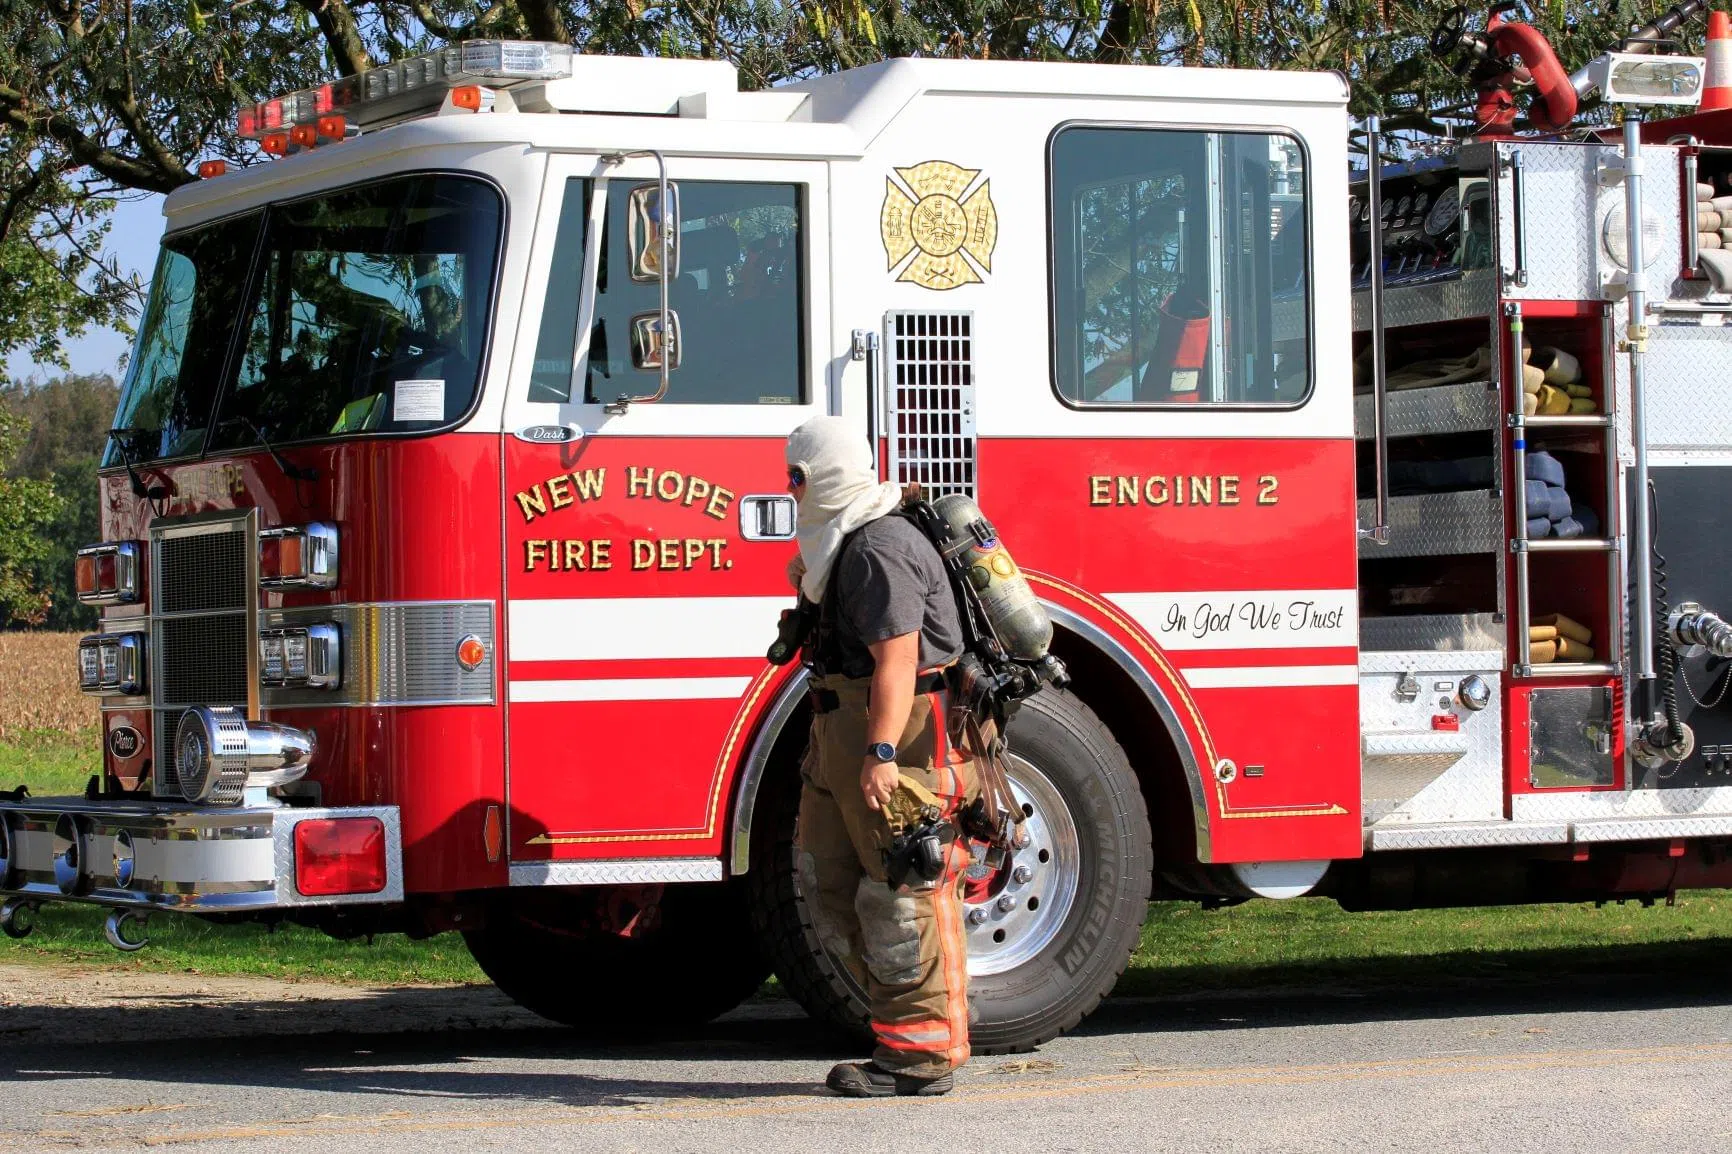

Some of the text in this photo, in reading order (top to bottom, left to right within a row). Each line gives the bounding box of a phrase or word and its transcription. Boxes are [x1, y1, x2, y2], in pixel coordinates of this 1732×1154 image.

[533, 427, 566, 441] Dash
[514, 465, 736, 522] NEW HOPE
[1089, 475, 1280, 507] ENGINE 2
[523, 538, 733, 572] FIRE DEPT.
[1160, 601, 1344, 639] In God We Trust
[113, 730, 135, 754] Pierce
[1063, 820, 1116, 975] MICHELIN
